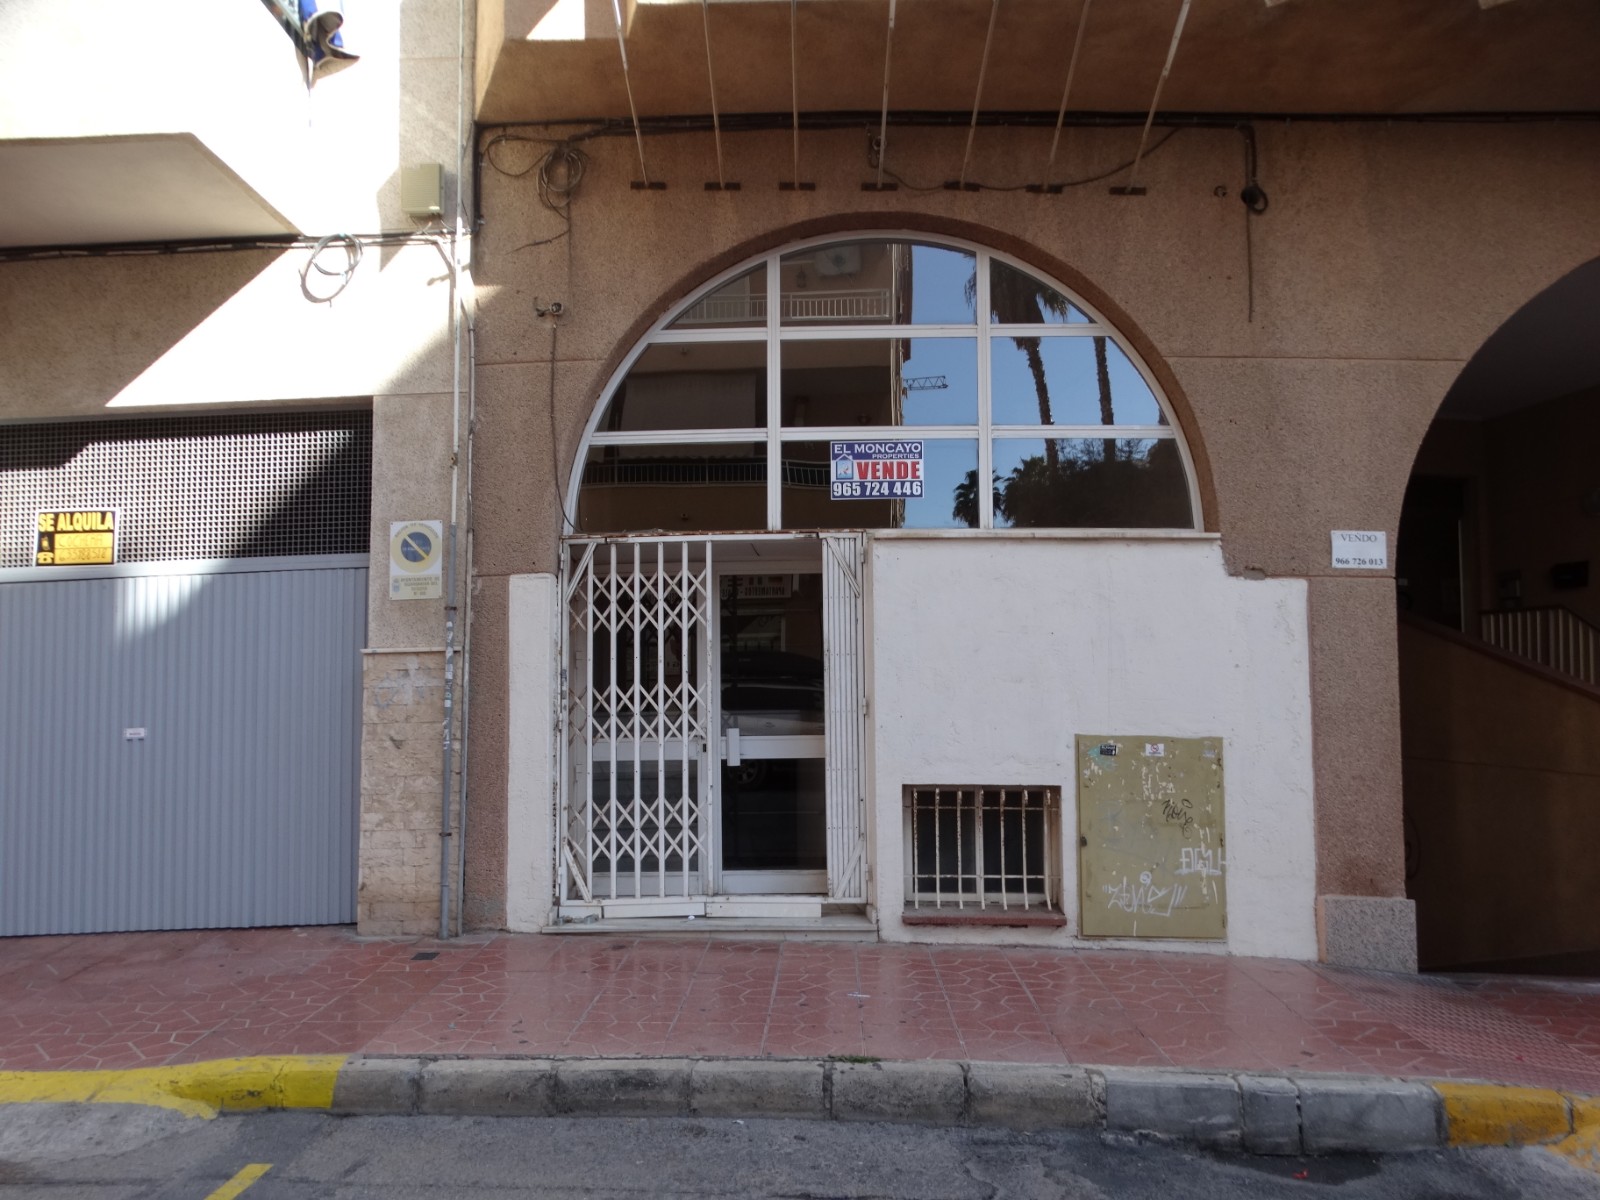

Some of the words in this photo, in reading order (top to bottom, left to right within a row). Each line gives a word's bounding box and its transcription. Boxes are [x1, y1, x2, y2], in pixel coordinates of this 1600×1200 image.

[834, 444, 851, 454] EL
[854, 443, 922, 454] MONCAYO
[856, 461, 921, 480] VENDE
[833, 482, 861, 497] 965
[864, 482, 889, 496] 724
[893, 481, 922, 496] 446
[38, 513, 55, 532] SE
[56, 511, 114, 532] ALQUILA
[1340, 533, 1378, 543] VENDO
[1335, 557, 1350, 565] 966
[1352, 557, 1367, 566] 726
